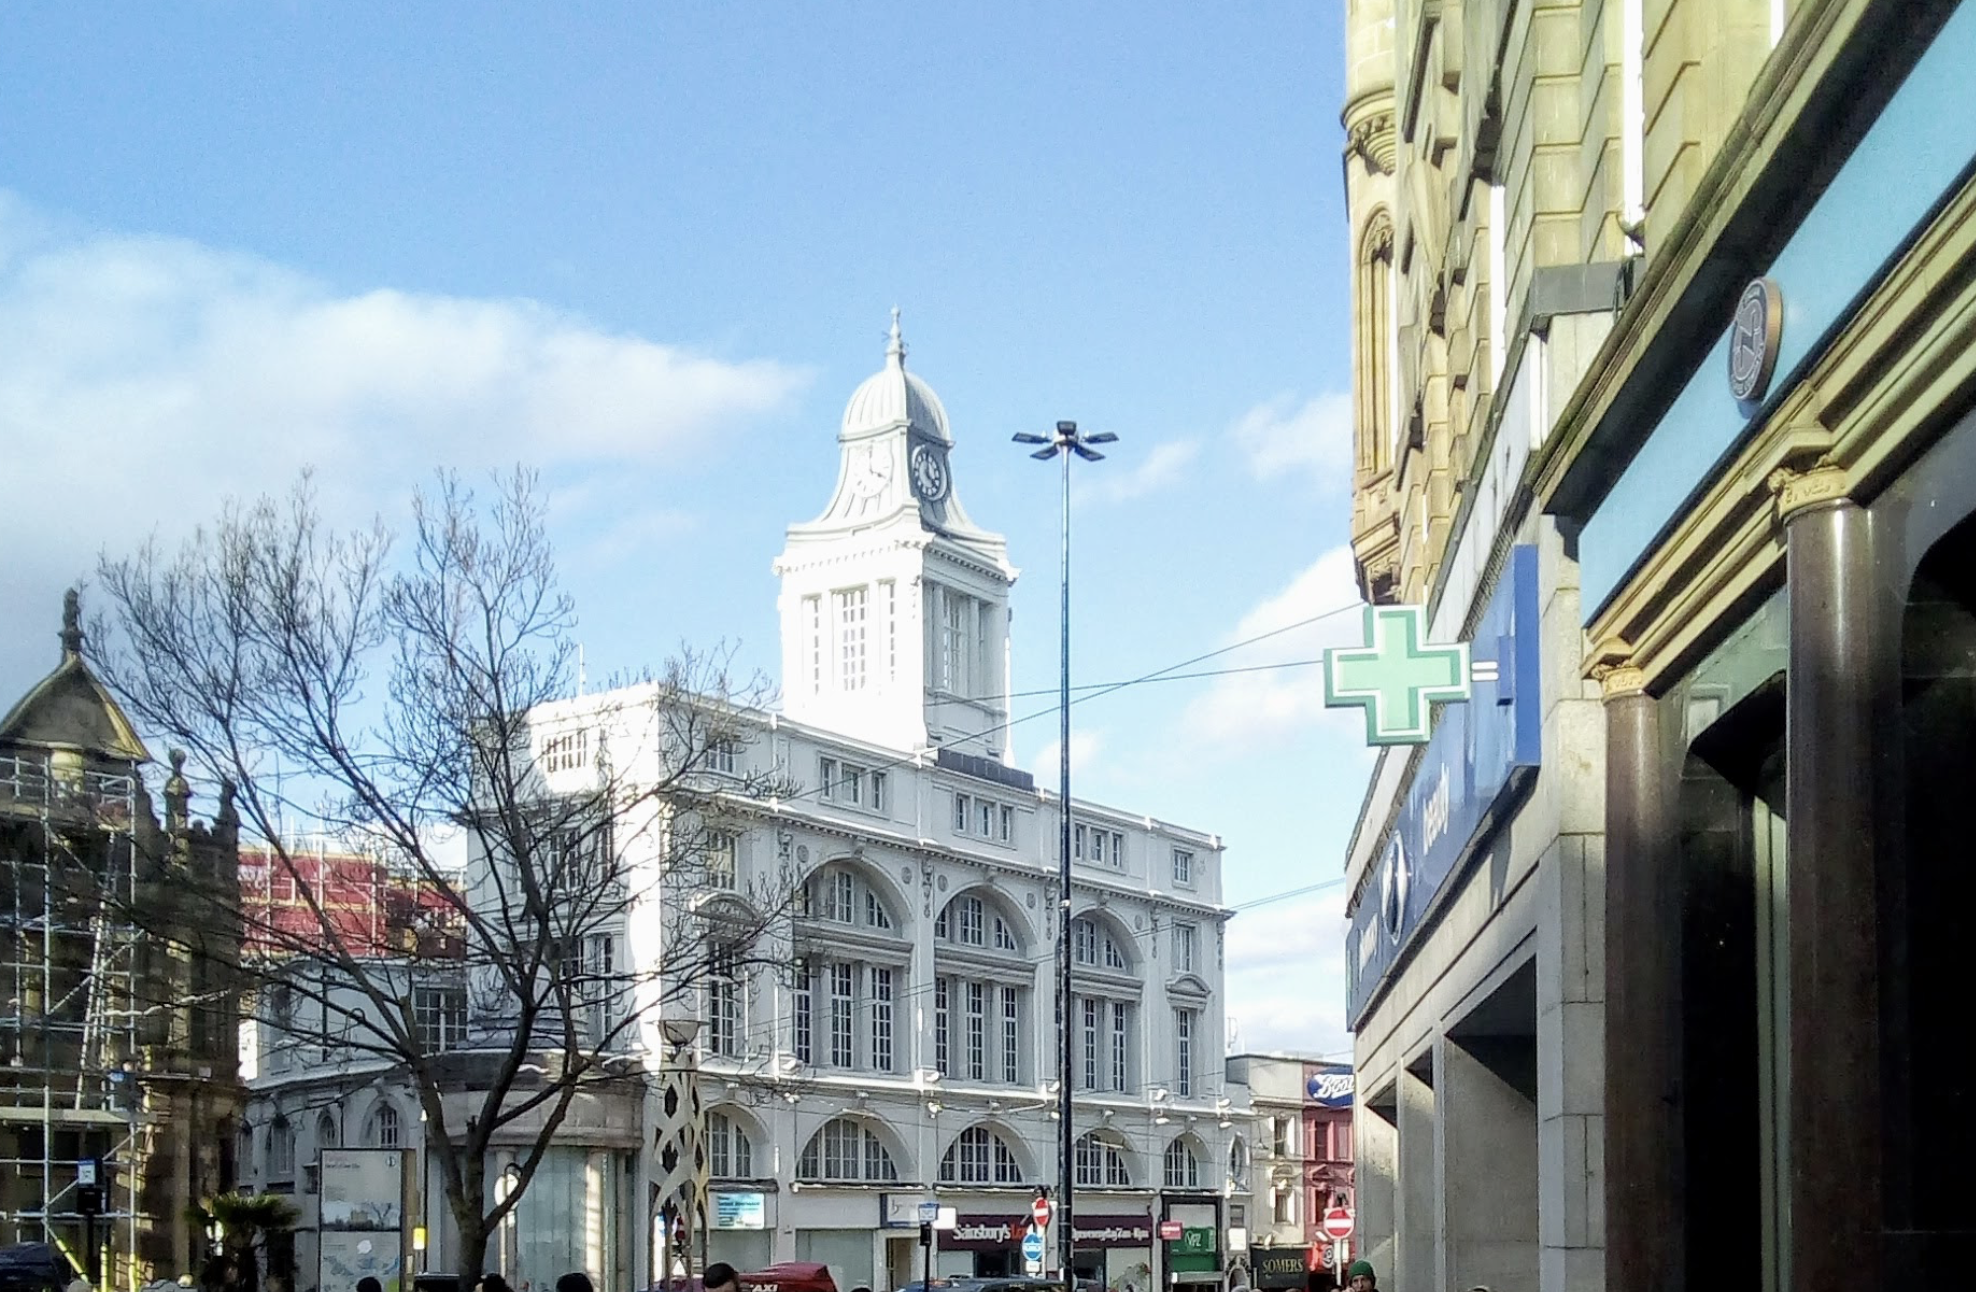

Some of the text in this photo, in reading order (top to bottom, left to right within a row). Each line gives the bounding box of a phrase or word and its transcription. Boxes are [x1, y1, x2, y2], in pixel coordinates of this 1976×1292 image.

[1312, 1074, 1355, 1099] Boot
[953, 1223, 1011, 1243] Sainsbury's
[1262, 1259, 1304, 1273] SOMERS
[750, 1284, 779, 1292] AXI
